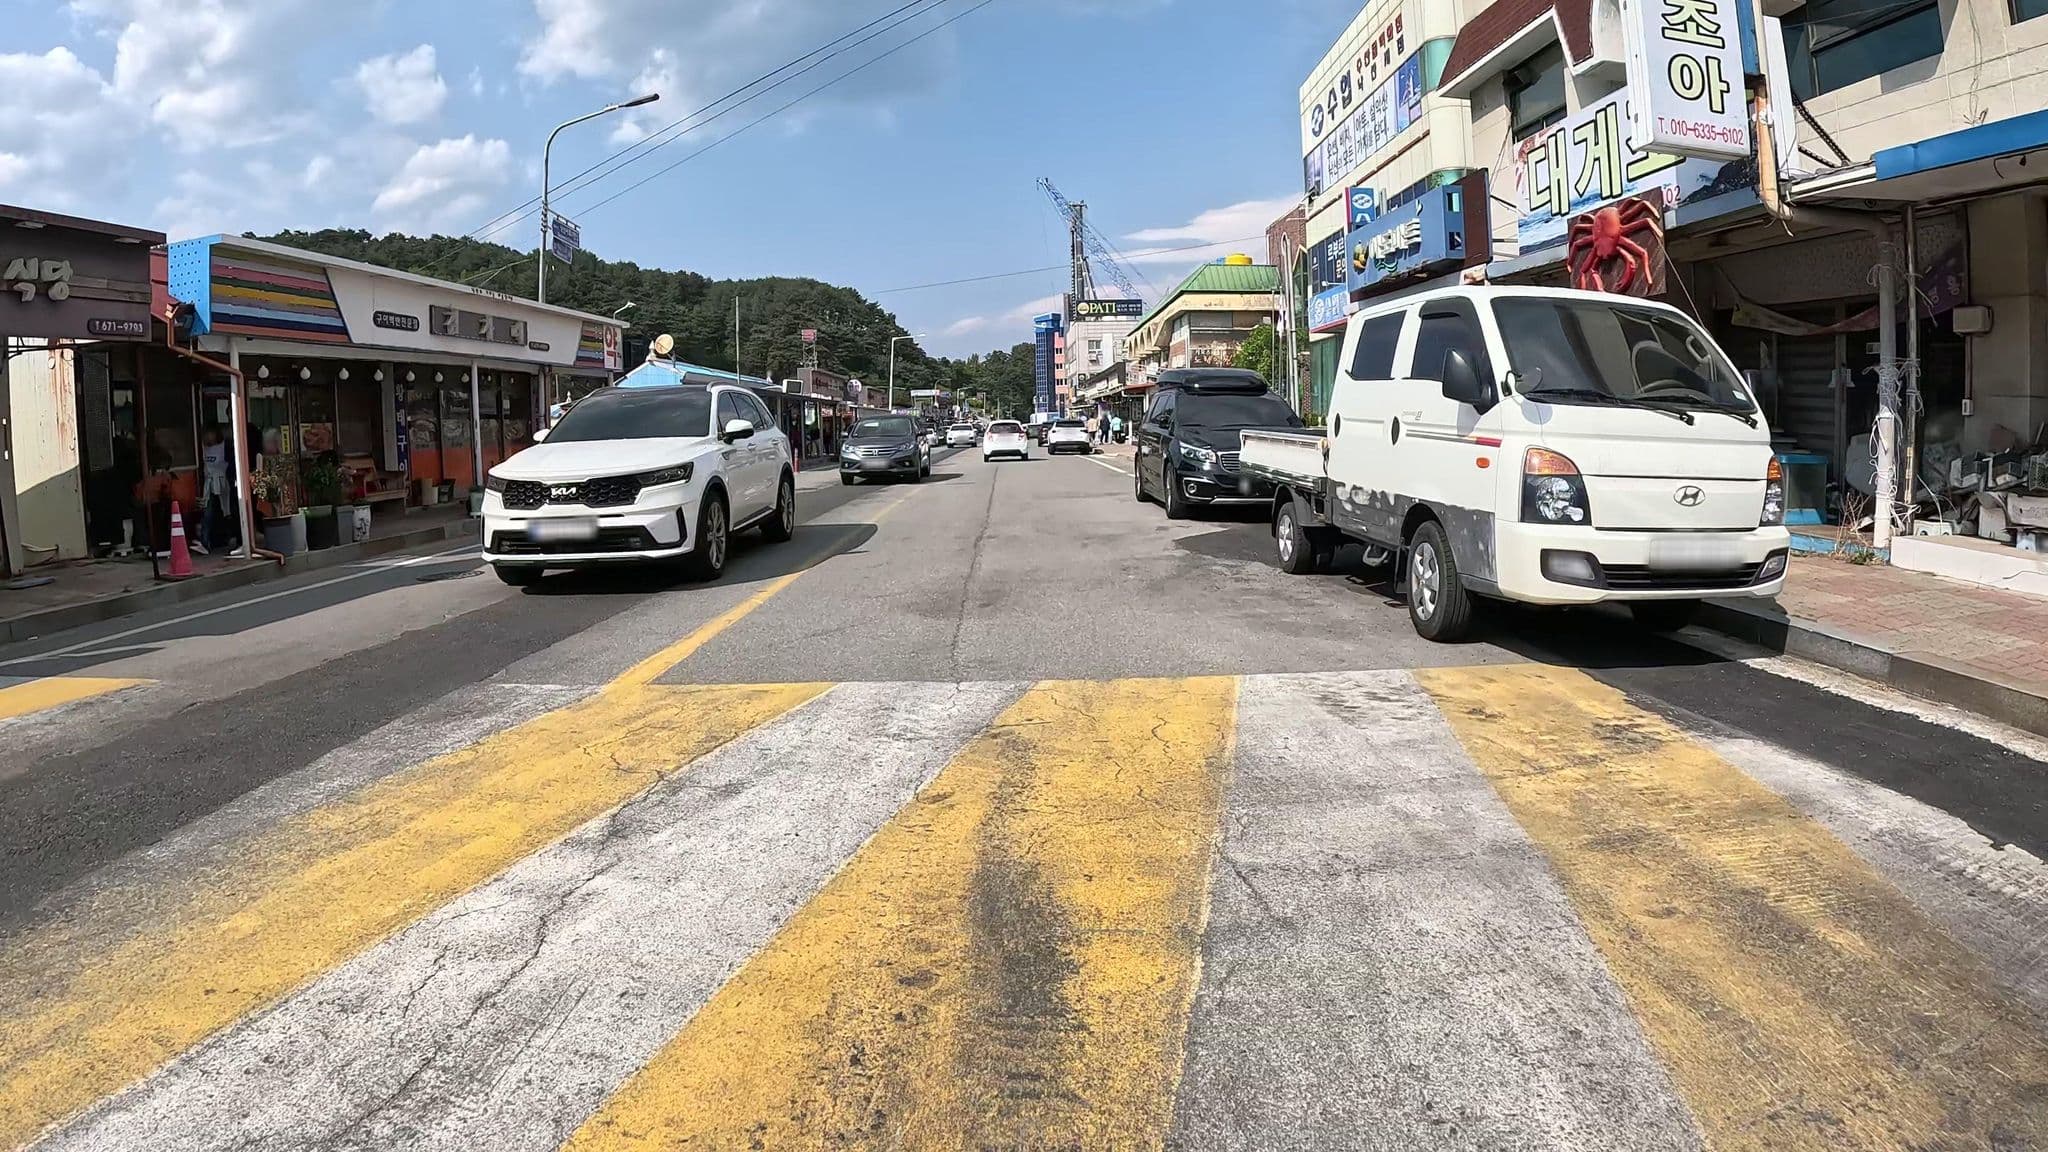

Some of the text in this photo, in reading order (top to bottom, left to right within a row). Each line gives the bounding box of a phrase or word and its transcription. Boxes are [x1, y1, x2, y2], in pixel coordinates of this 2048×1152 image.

[1661, 0, 1730, 114] 조아
[1327, 68, 1353, 121] 수협
[1670, 119, 1744, 145] 010-6335-6102
[1343, 145, 1354, 166] 모든
[3, 257, 74, 302] 식당
[1088, 302, 1117, 314] PATI
